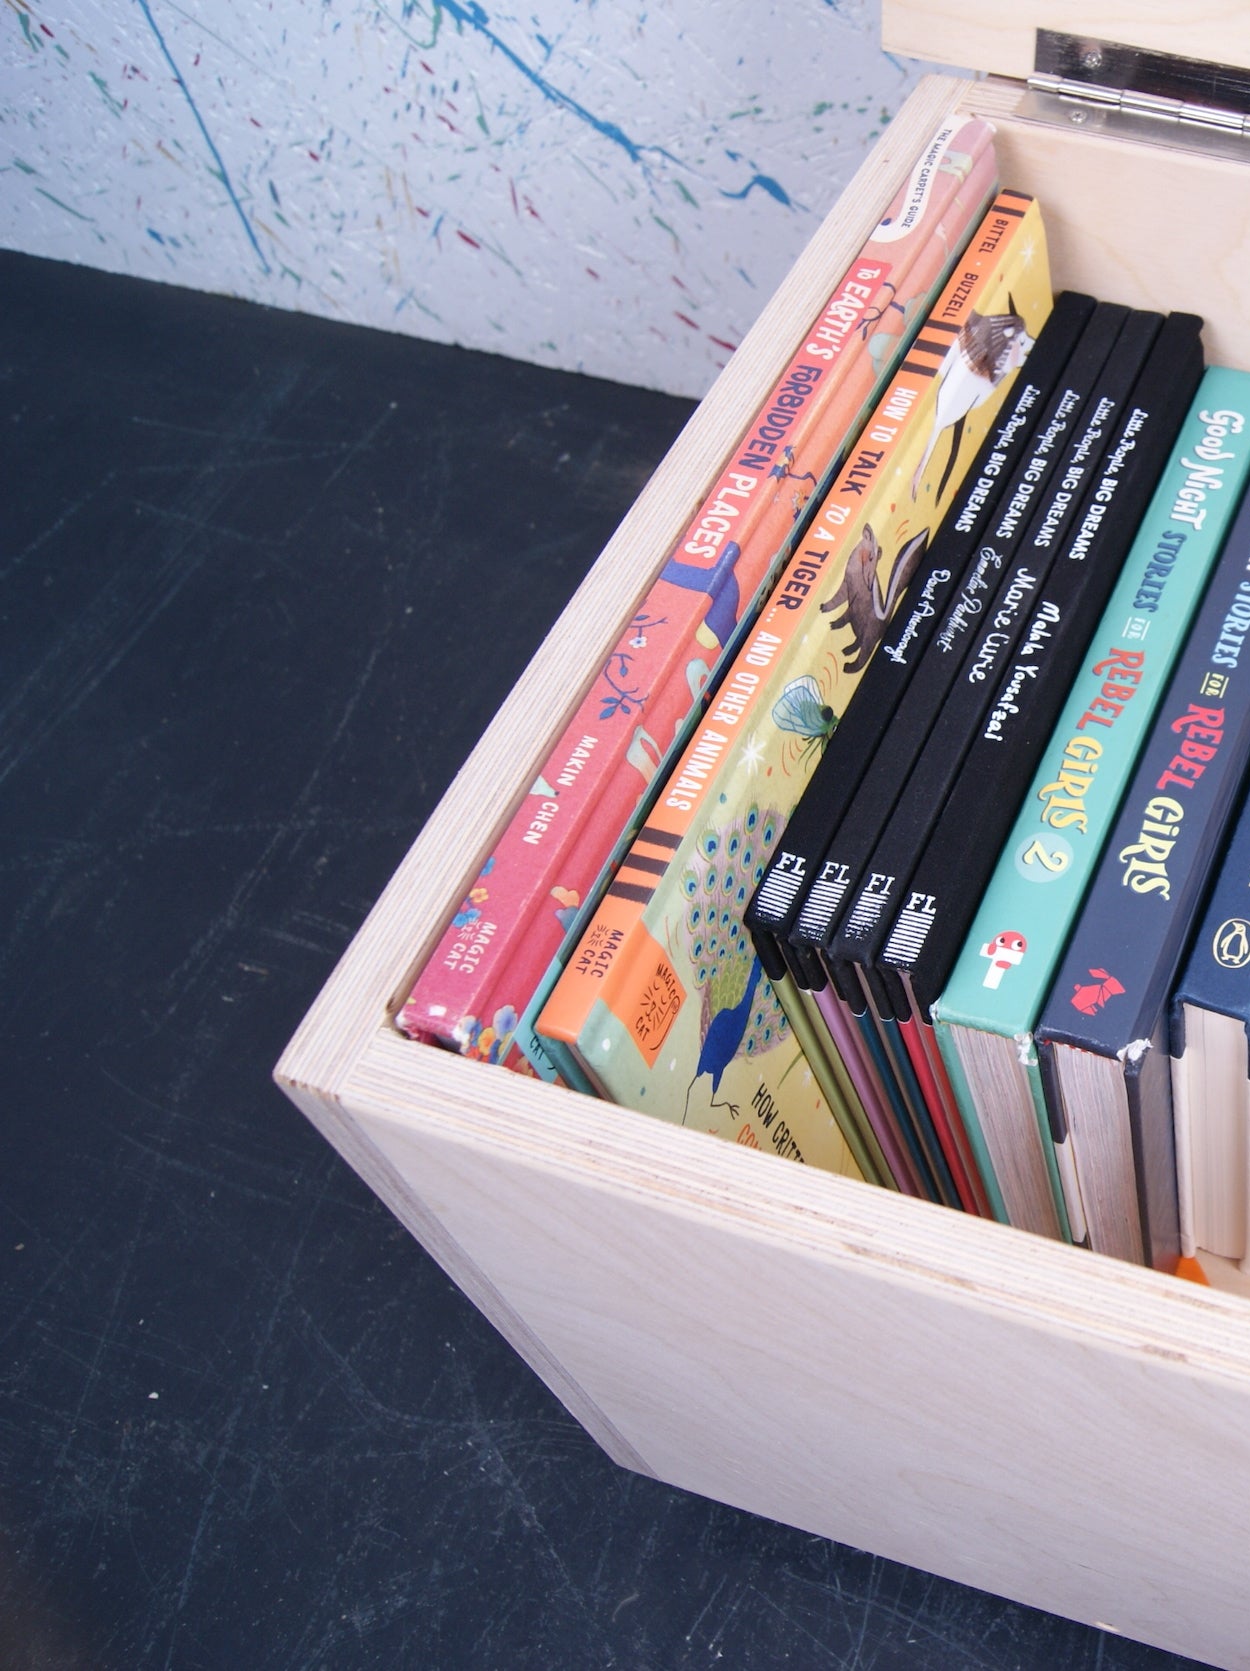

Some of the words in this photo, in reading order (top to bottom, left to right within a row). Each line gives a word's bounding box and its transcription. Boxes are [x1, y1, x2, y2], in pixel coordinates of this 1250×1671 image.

[937, 129, 952, 142] THE
[924, 144, 940, 166] MAGIC
[911, 168, 930, 205] CARPET'S
[901, 204, 919, 228] GUIDE
[978, 218, 1008, 254] BITTEL
[942, 272, 979, 318] BUZZELL
[806, 281, 868, 360] EARTH'S
[738, 364, 823, 470] FORBIDDEN
[883, 387, 918, 421] HOW
[1015, 384, 1040, 413] Little
[1054, 389, 1080, 419] Little
[870, 425, 898, 443] TO
[1124, 408, 1149, 439] Little
[840, 450, 885, 496] TALK
[984, 452, 1007, 476] BIG
[1024, 457, 1047, 482] BIG
[955, 477, 994, 533] DREAMS
[1095, 477, 1119, 502] BIG
[684, 472, 757, 559] PLACES
[824, 503, 851, 525] TO
[996, 483, 1034, 539] DREAMS
[813, 527, 836, 542] A
[1069, 504, 1106, 561] DREAMS
[921, 569, 951, 601] David
[1133, 530, 1187, 613] STORIES
[994, 568, 1037, 629] Marie
[1020, 601, 1061, 655] Malala
[1126, 617, 1147, 640] FOR
[745, 630, 782, 667] AND
[969, 633, 1011, 684] Curie
[711, 672, 759, 725] OTHER
[984, 665, 1039, 741] Yousafzai
[1076, 647, 1145, 731] REBEL
[1205, 672, 1225, 697] FOR
[556, 735, 598, 787] MAKIN
[1156, 703, 1225, 790] REBEL
[665, 729, 728, 812] ANIMALS
[522, 801, 559, 845] CHEN
[1022, 840, 1069, 872] 2
[444, 942, 467, 970] CAT
[459, 921, 497, 974] MAGIC
[656, 963, 677, 999] MAGIC
[635, 1016, 650, 1042] CAT
[751, 1082, 778, 1129] HOW
